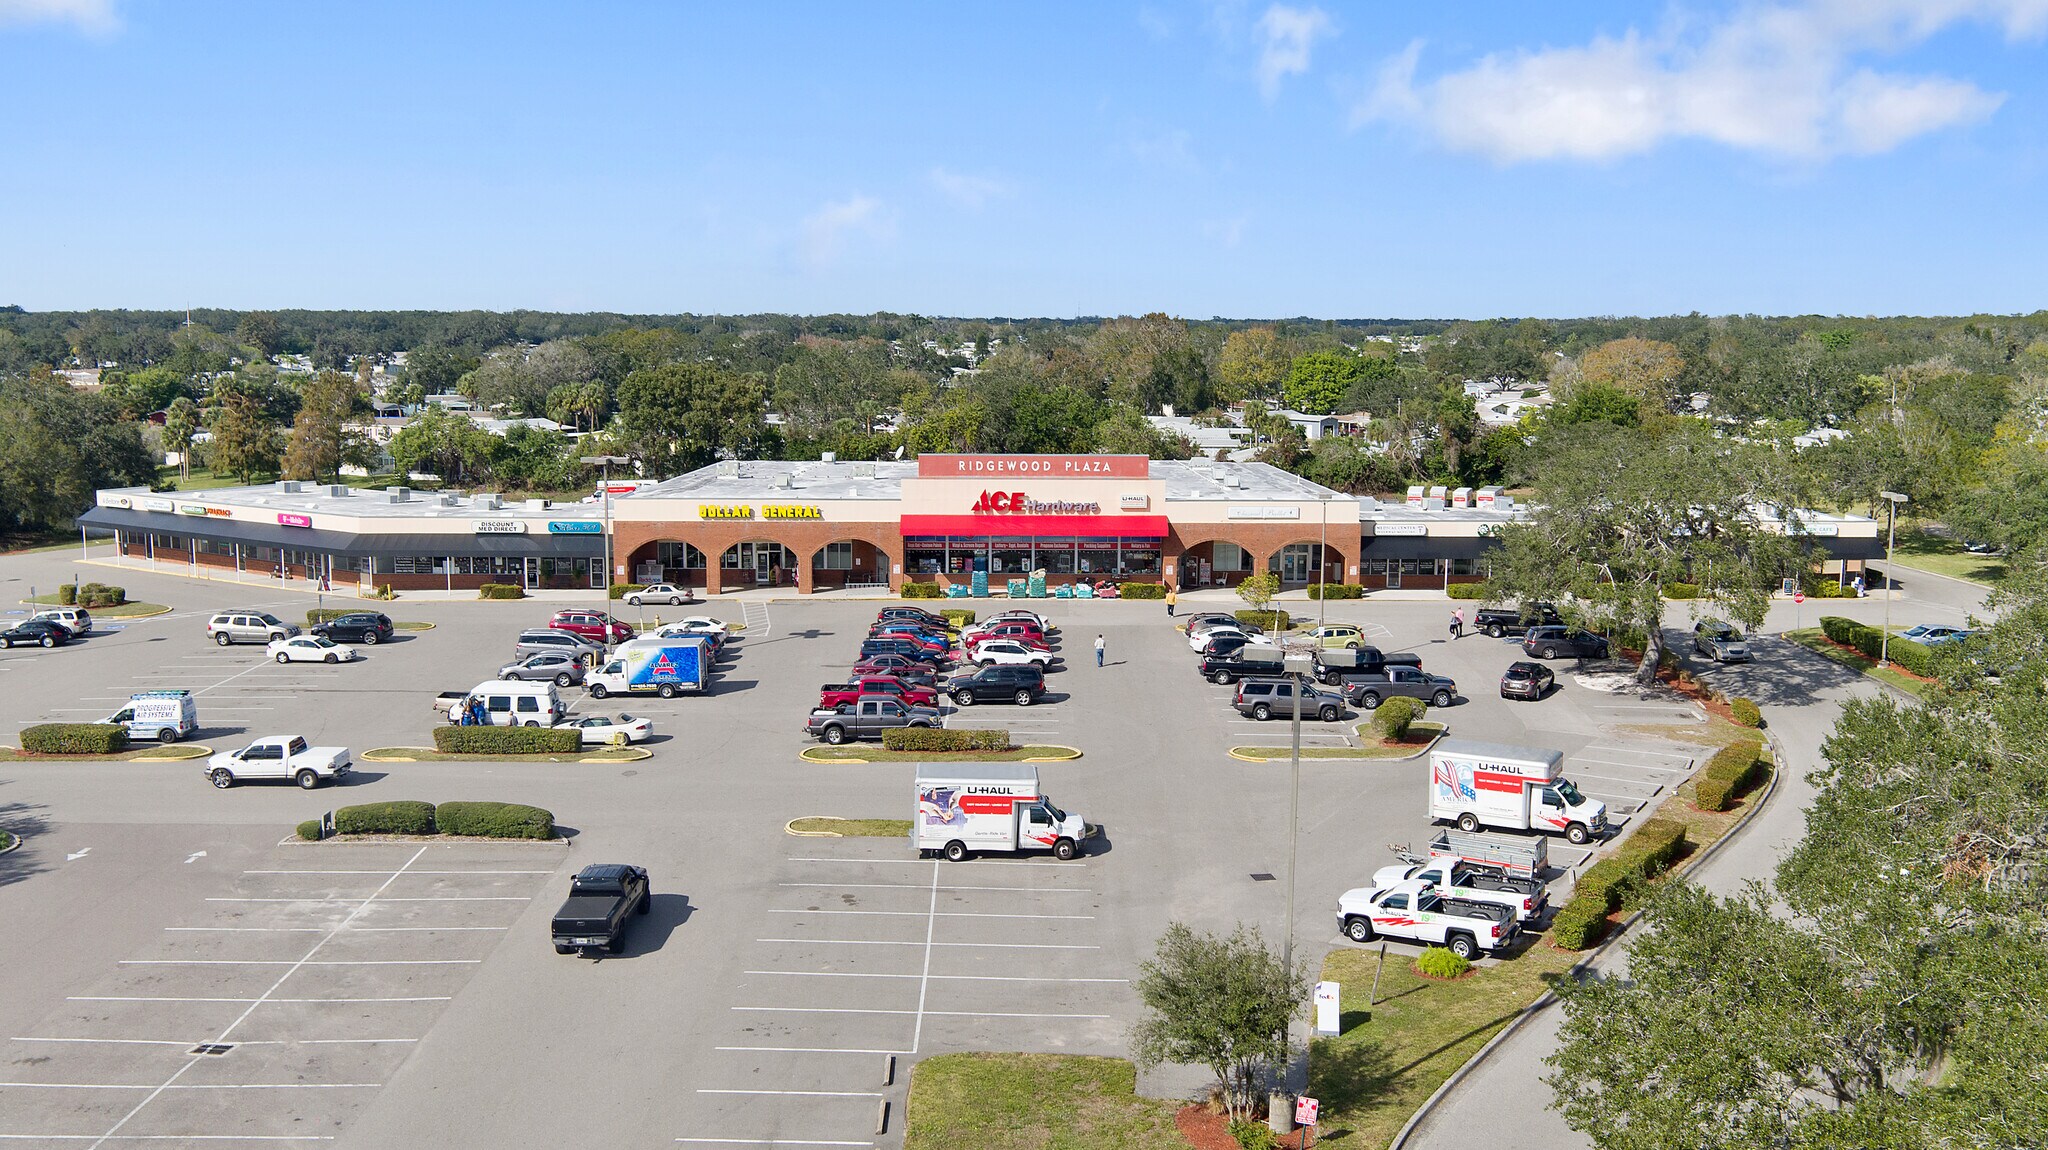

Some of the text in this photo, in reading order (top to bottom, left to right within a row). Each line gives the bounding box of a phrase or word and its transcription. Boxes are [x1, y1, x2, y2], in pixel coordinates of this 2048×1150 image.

[958, 460, 1111, 472] RIDGEWOOD PLAZA
[971, 489, 1098, 512] ACE Hardware
[698, 504, 821, 518] DOLLAR GENERAL
[1478, 762, 1524, 775] U-HAUL
[967, 786, 1014, 795] U-HAUL
